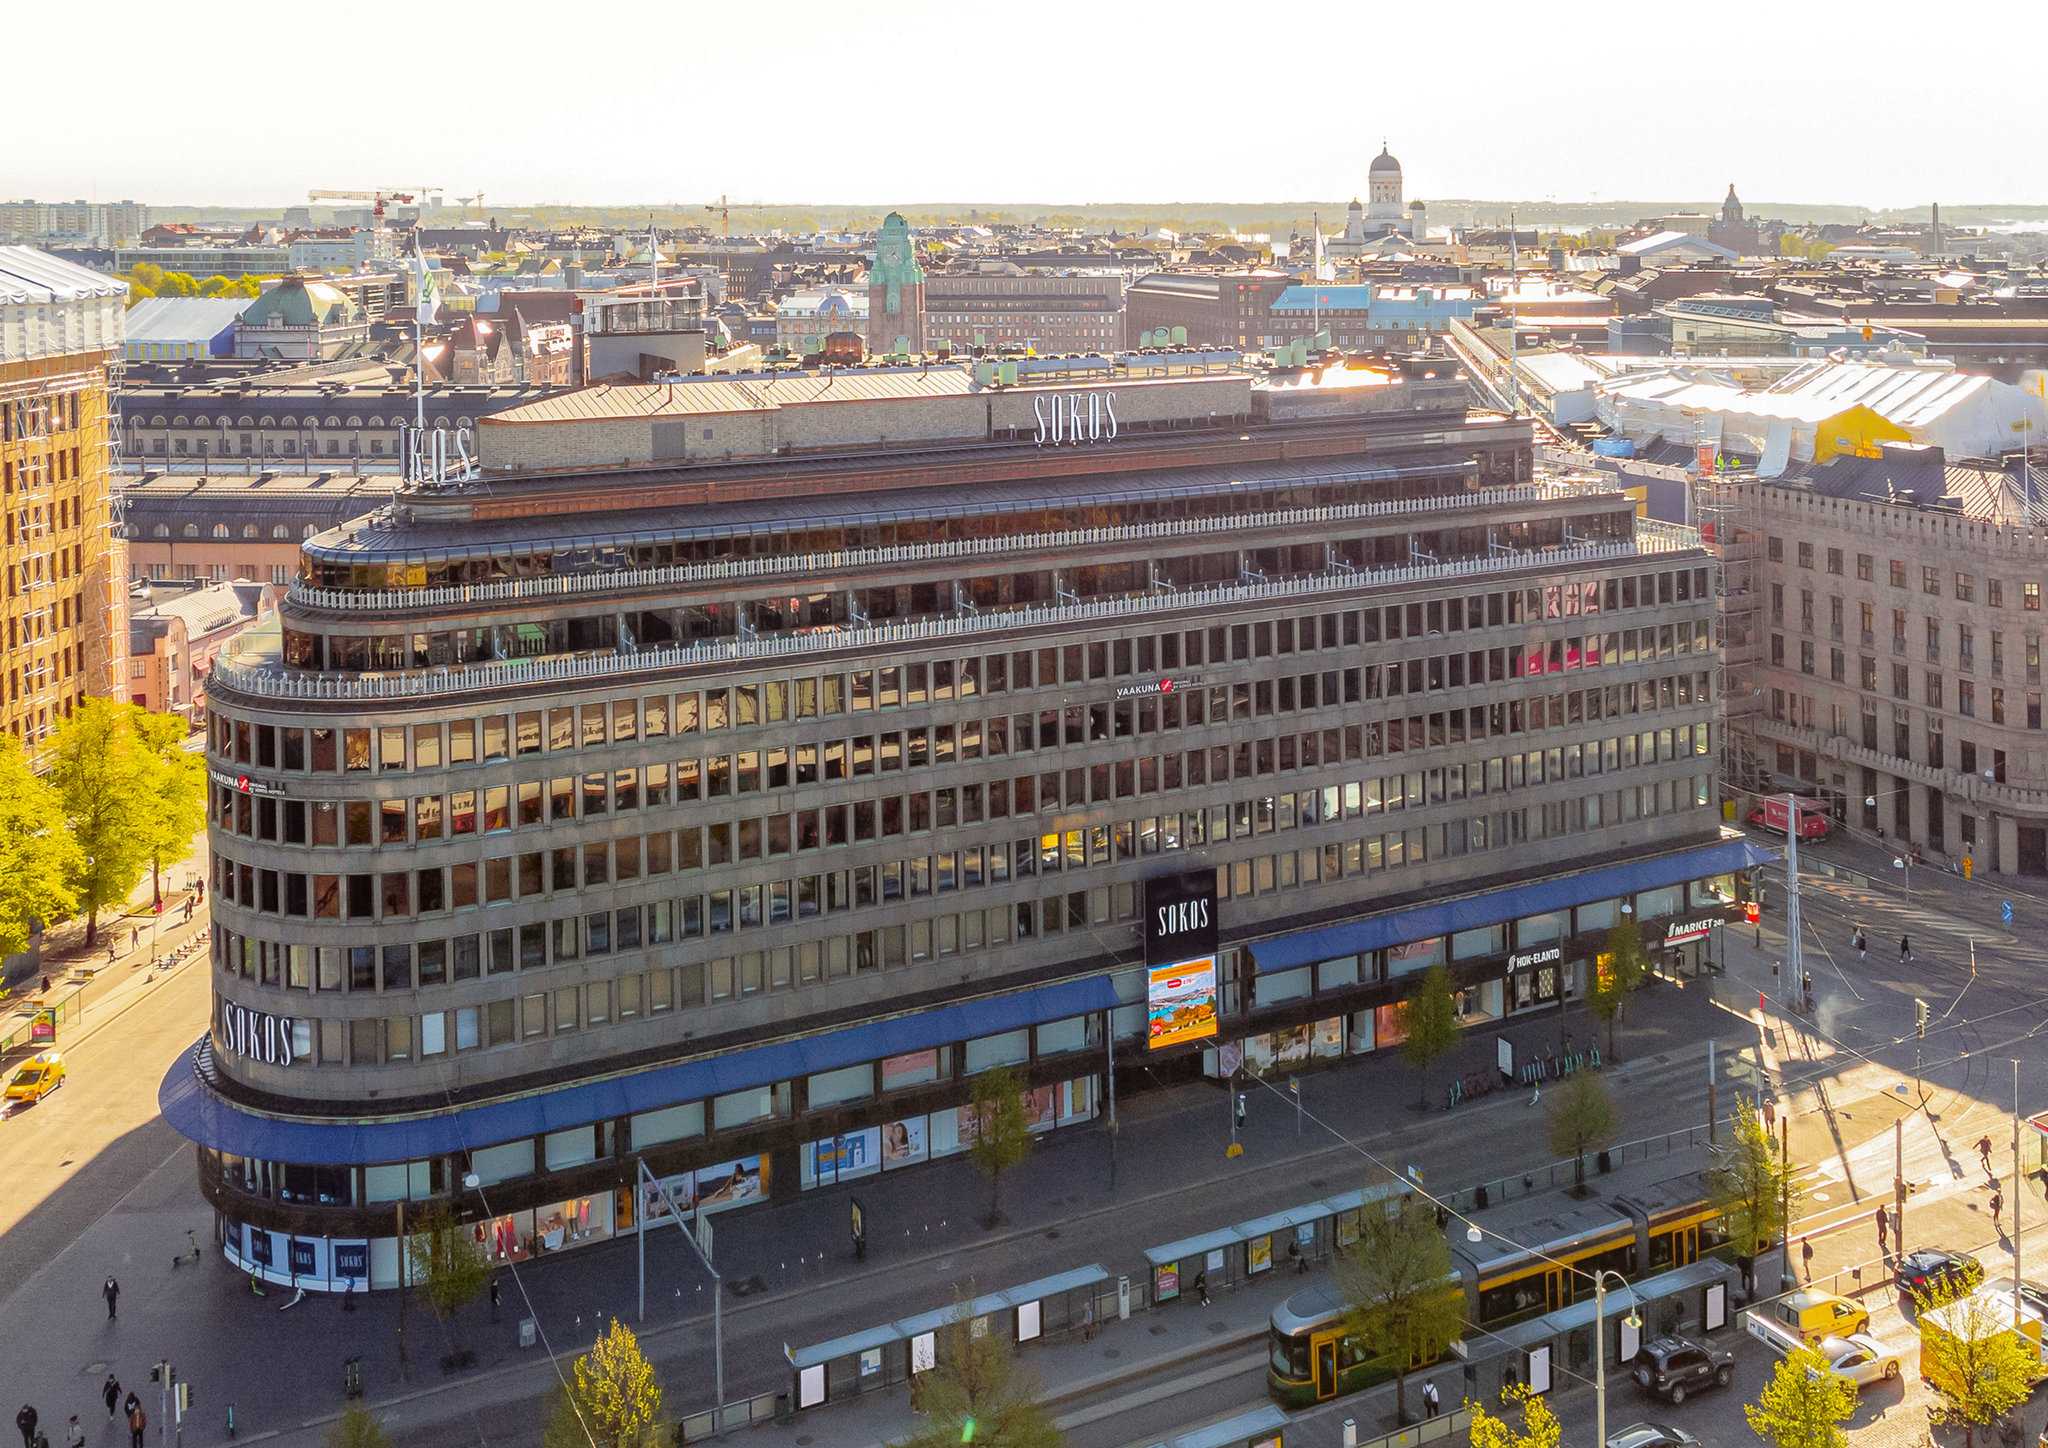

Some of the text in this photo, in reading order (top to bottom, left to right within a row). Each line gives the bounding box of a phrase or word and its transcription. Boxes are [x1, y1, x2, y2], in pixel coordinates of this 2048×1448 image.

[1033, 391, 1117, 443] SOKOS
[1116, 684, 1160, 697] VAAKUNA
[1158, 898, 1208, 936] SOKOS
[1516, 948, 1560, 968] HOK-ELANTO
[225, 1003, 291, 1066] SOKOS
